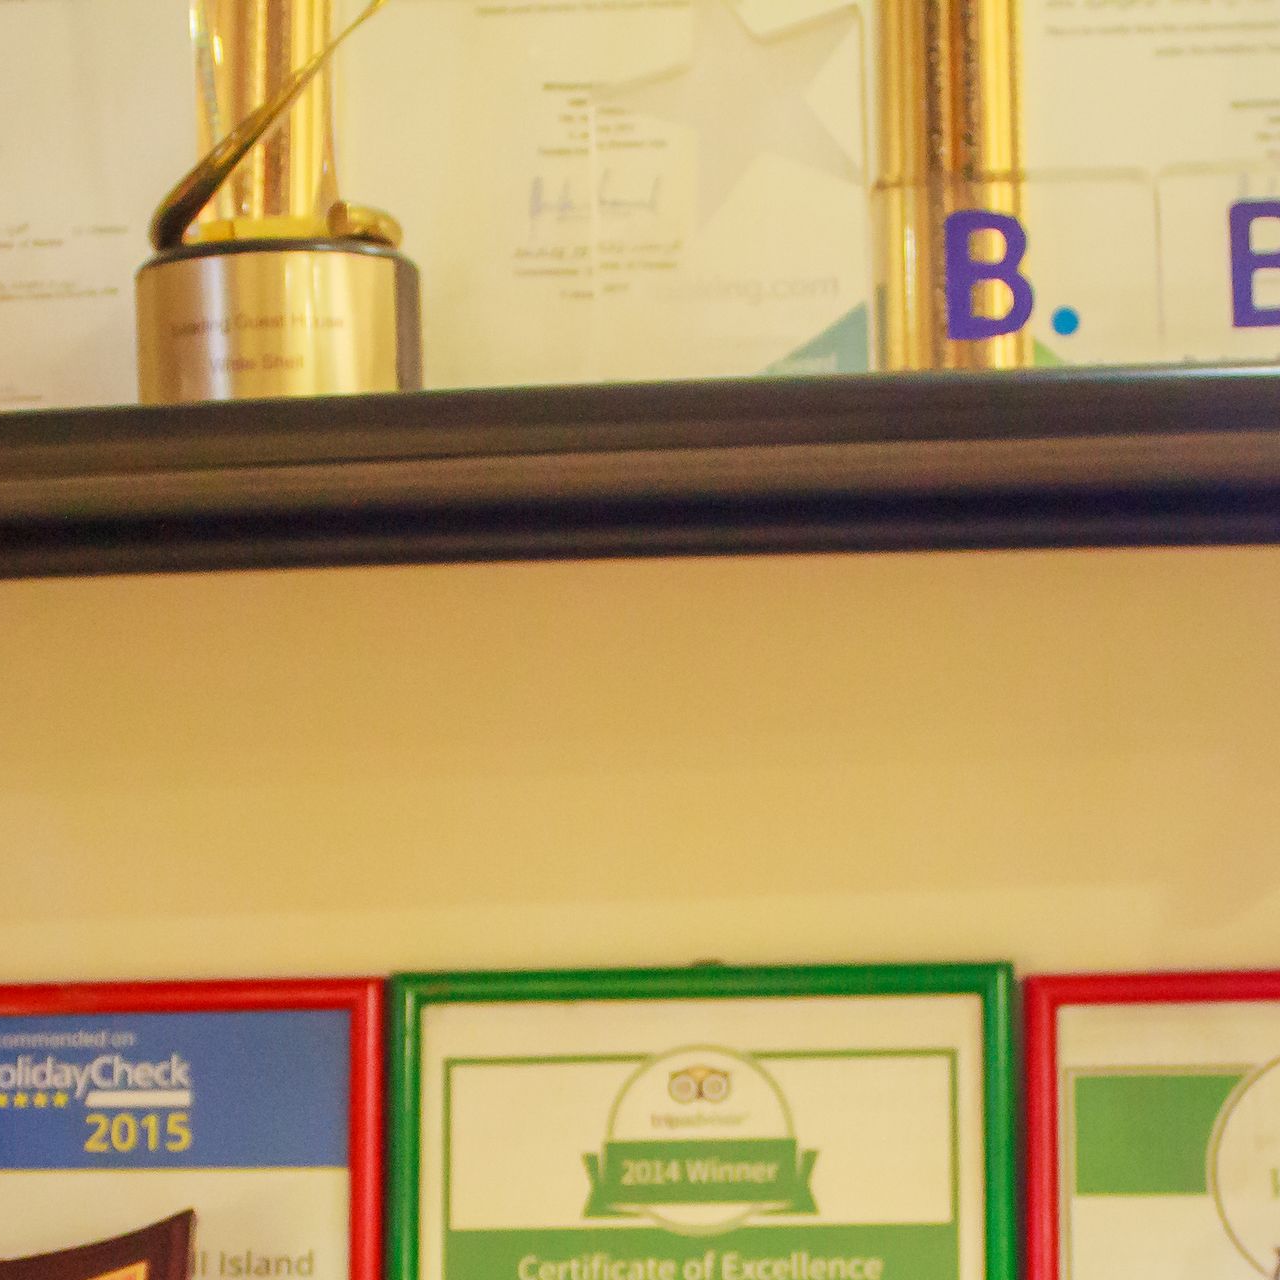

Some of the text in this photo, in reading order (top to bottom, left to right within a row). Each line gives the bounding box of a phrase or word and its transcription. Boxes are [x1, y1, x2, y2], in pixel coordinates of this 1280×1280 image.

[111, 1033, 136, 1048] on
[84, 1113, 192, 1153] 2015
[620, 1156, 777, 1186] 2014 Winner
[220, 1250, 314, 1277] Island
